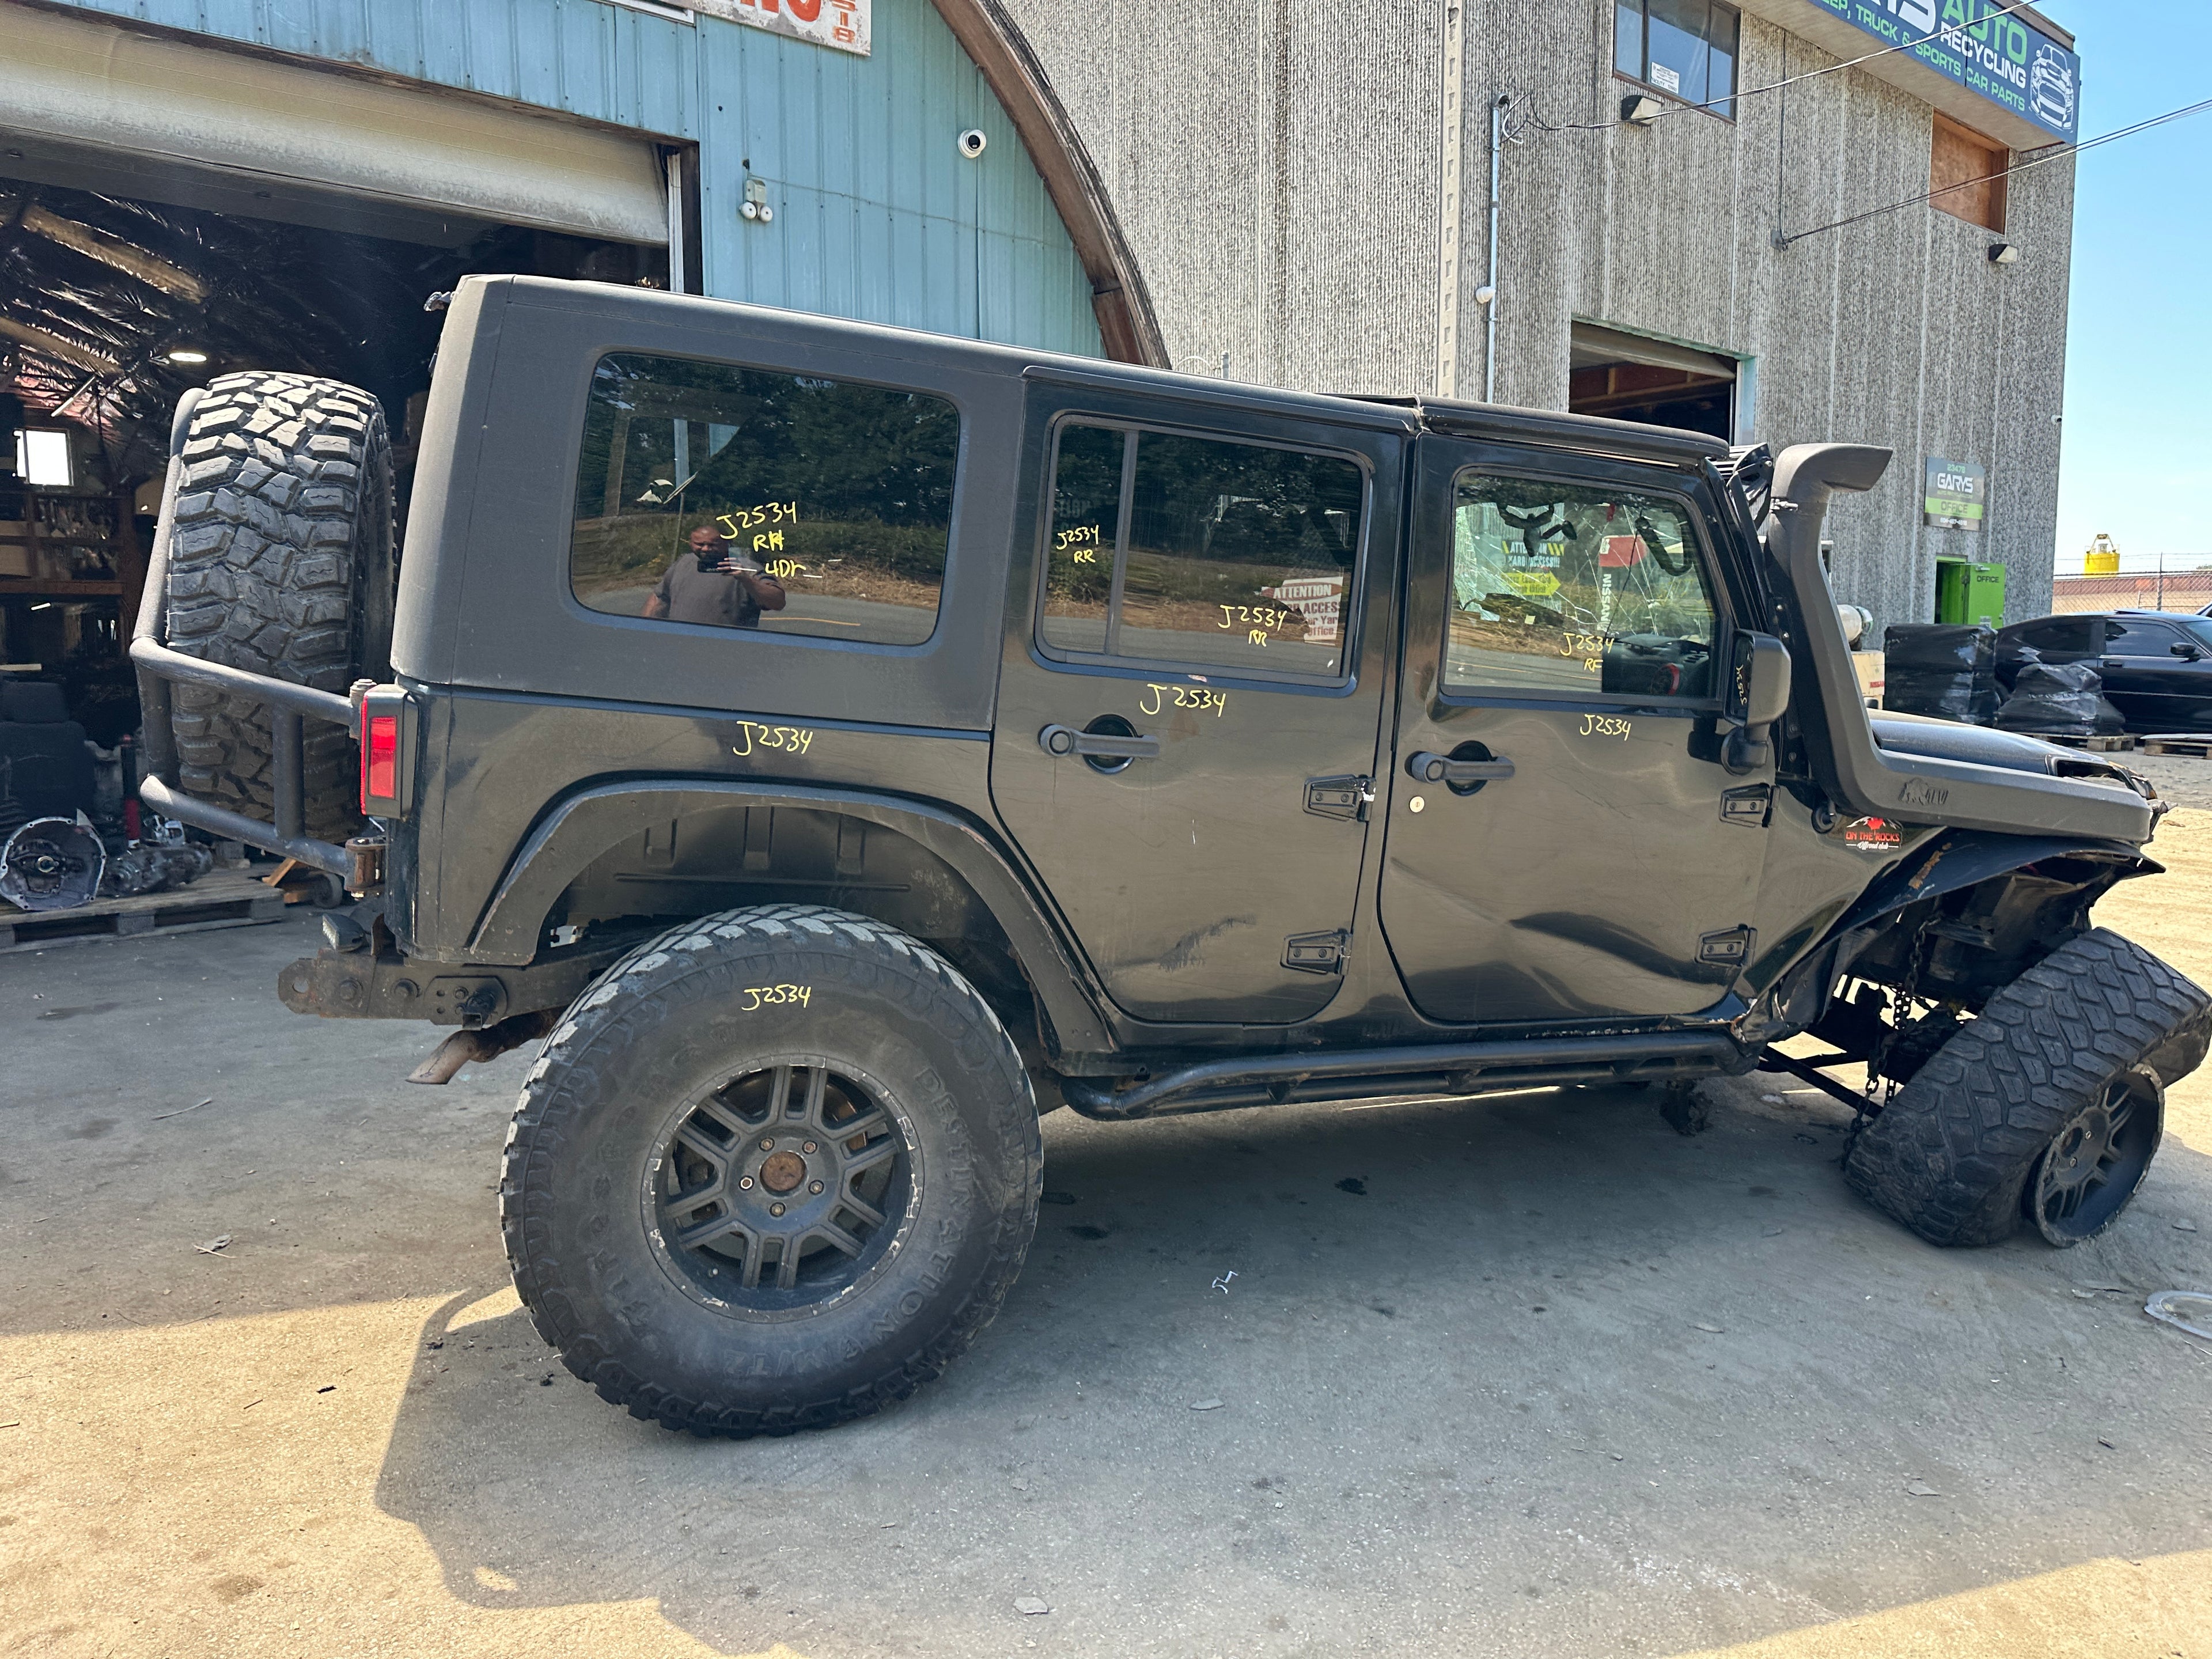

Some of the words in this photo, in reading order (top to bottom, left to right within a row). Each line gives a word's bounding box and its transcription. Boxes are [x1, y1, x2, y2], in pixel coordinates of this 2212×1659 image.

[1942, 0, 2027, 65] AUTO
[1856, 4, 1897, 41] TRUCK
[1915, 40, 1961, 76] SPORTS
[1966, 67, 1988, 91] CAR
[1991, 81, 2025, 111] PARTS
[1940, 21, 2026, 88] RECYCLING
[1937, 472, 1973, 493] GARYS
[716, 501, 797, 540] J2534
[1941, 501, 1968, 514] OFFICE
[1056, 524, 1099, 550] J2534
[1074, 548, 1096, 563] RR
[1273, 585, 1332, 599] ATTENTION
[1601, 574, 1612, 622] NISSAN
[1217, 604, 1287, 631] J2534
[1559, 632, 1614, 656] J2534
[1583, 657, 1603, 672] RF
[1139, 683, 1226, 718] J2534
[733, 720, 813, 756] J2534
[1580, 714, 1632, 741] J2534
[1845, 831, 1857, 840] ON
[1859, 831, 1874, 841] THE
[1876, 832, 1900, 842] ROCKS
[742, 984, 812, 1011] J2534
